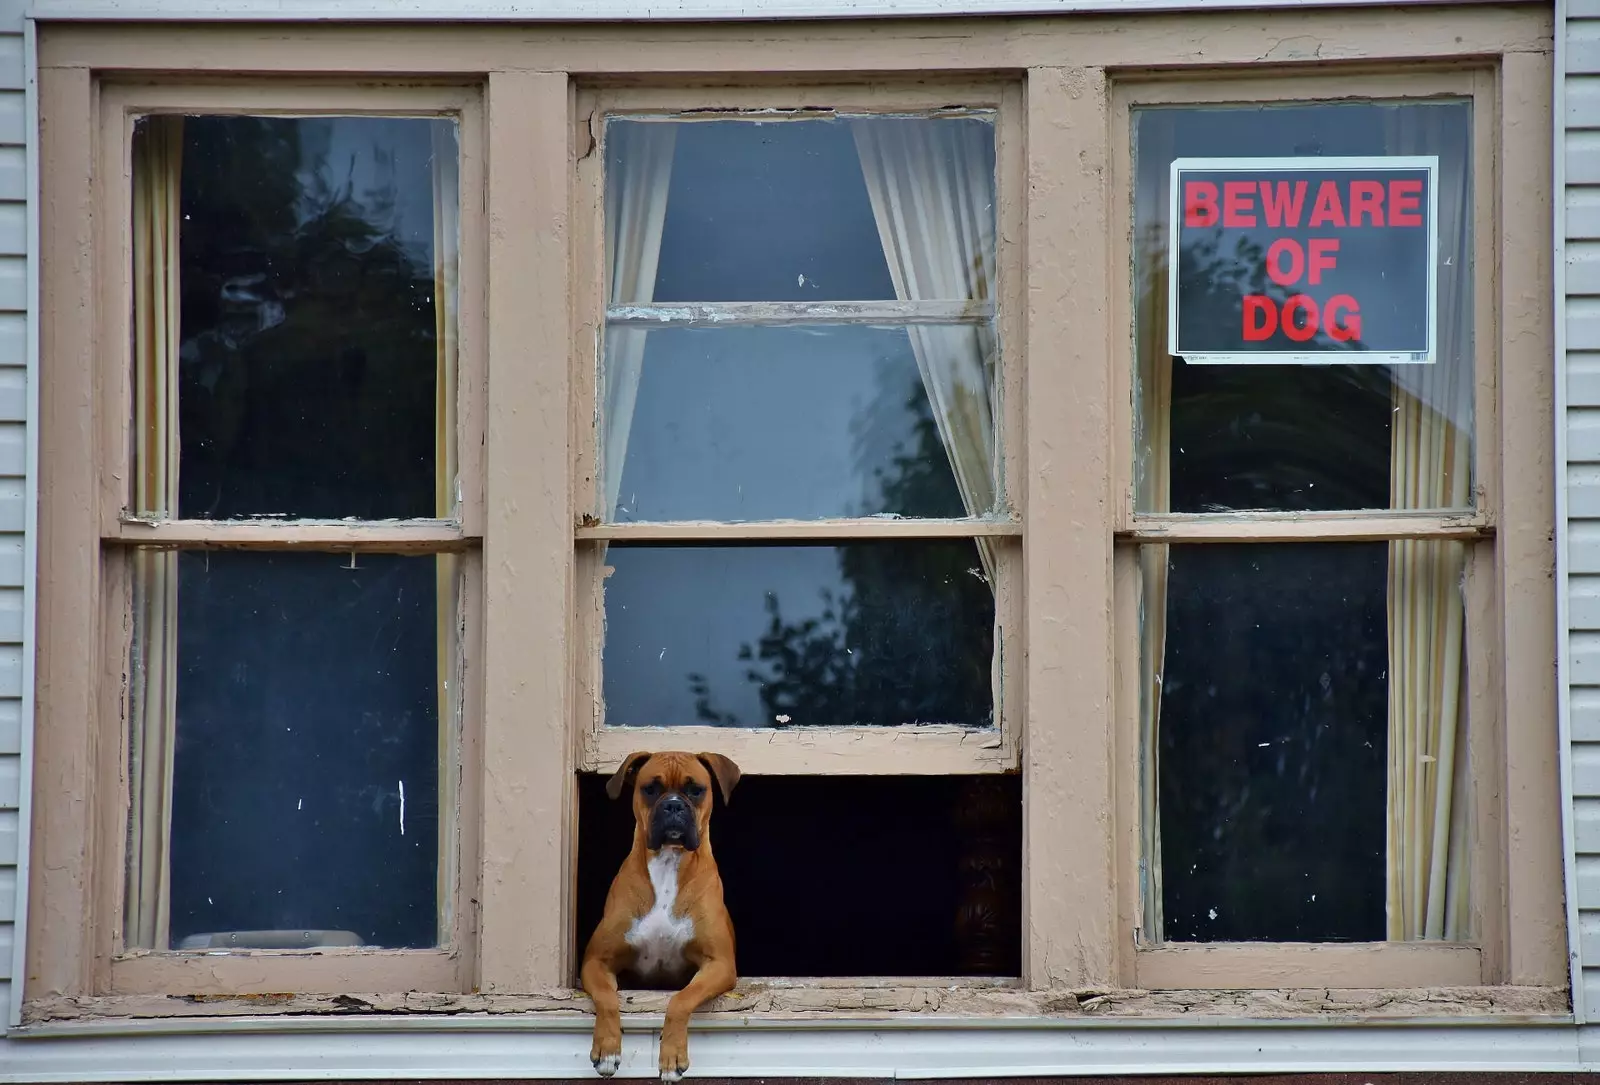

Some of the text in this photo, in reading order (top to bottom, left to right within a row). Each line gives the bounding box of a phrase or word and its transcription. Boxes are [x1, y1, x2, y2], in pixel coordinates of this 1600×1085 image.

[1185, 181, 1423, 227] BEWARE
[1265, 238, 1340, 286] OF
[1242, 294, 1361, 342] DOG
